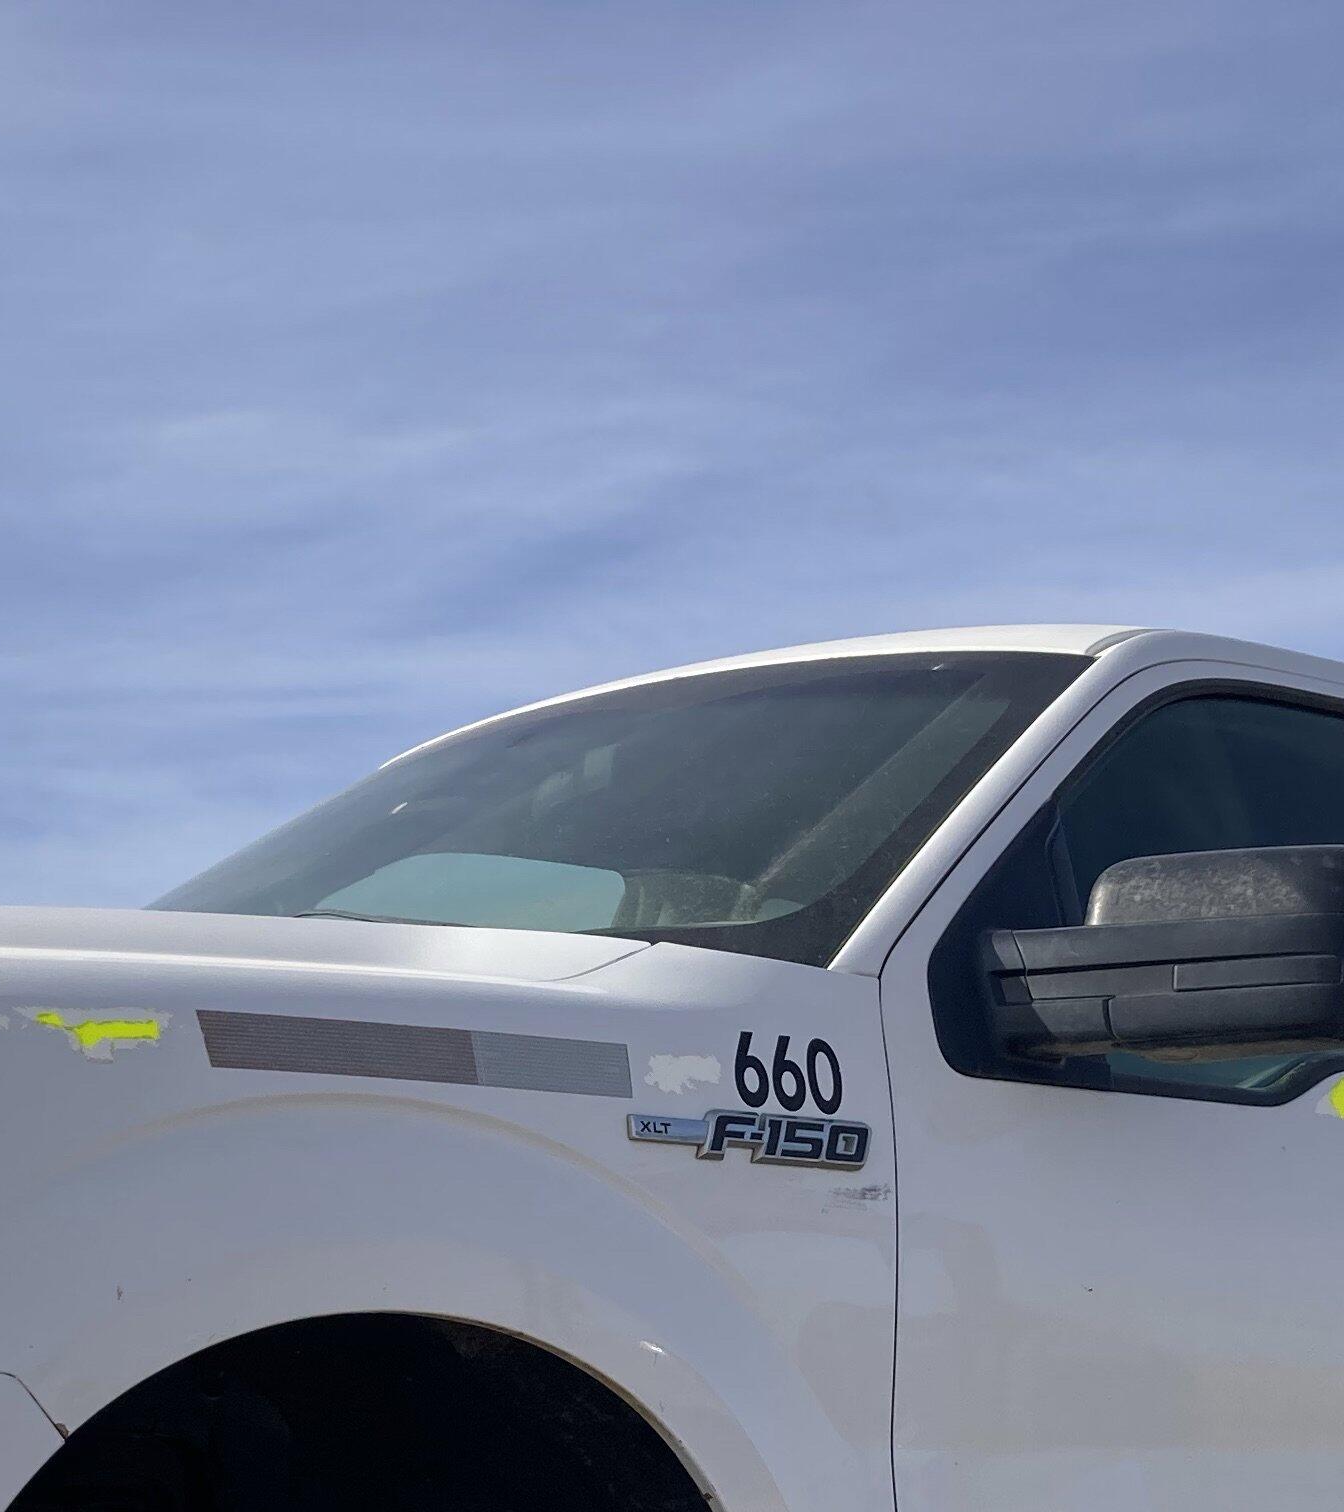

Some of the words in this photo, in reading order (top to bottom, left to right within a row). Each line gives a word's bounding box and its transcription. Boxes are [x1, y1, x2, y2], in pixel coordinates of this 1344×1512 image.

[734, 1030, 843, 1115] 660
[639, 1119, 672, 1135] XLT
[706, 1112, 870, 1166] F-150
